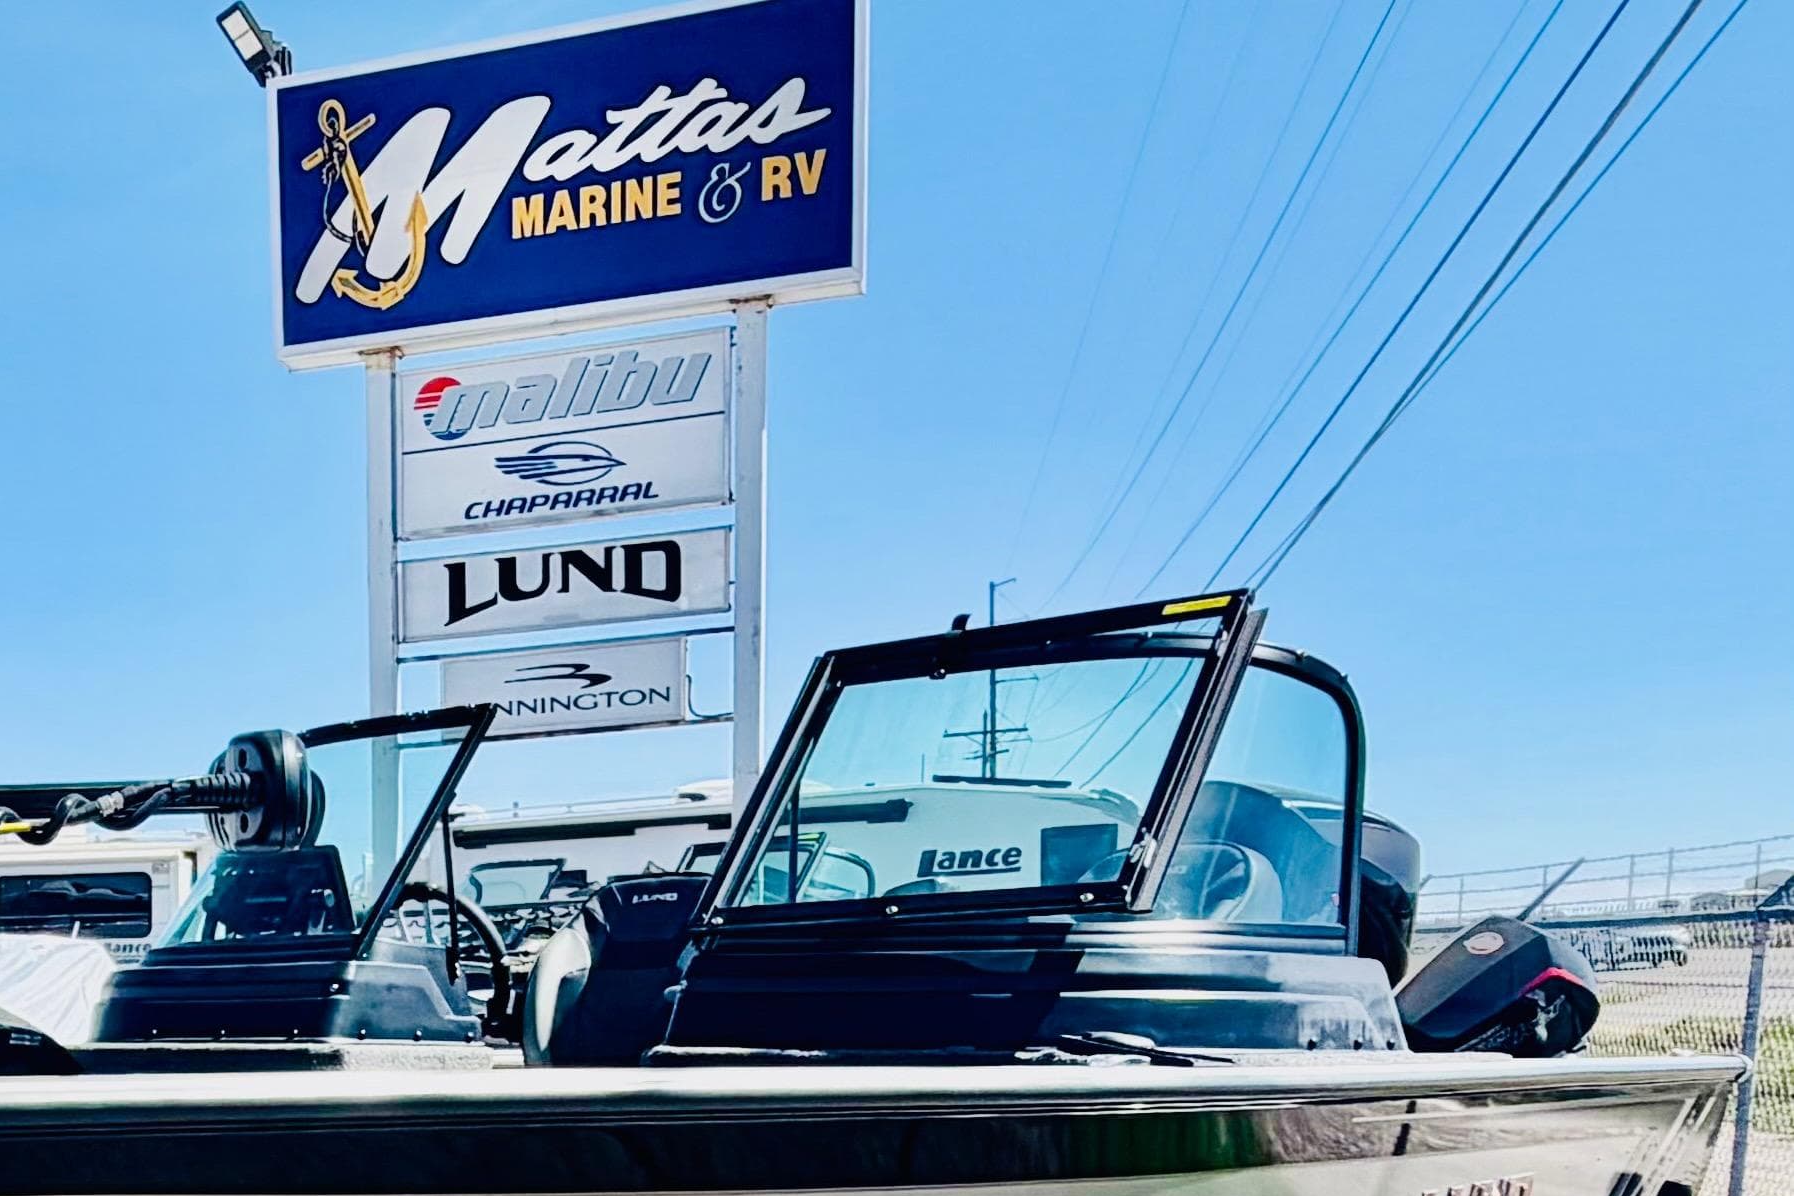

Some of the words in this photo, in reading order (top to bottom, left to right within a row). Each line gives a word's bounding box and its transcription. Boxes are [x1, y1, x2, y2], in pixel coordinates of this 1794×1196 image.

[296, 77, 832, 303] Mattas
[511, 171, 682, 239] MARINE
[698, 161, 752, 224] &
[761, 148, 828, 202] RV
[429, 350, 712, 434] malibu
[463, 480, 660, 520] CHAPARRAL
[442, 540, 682, 627] LUND
[916, 846, 1023, 878] Lance
